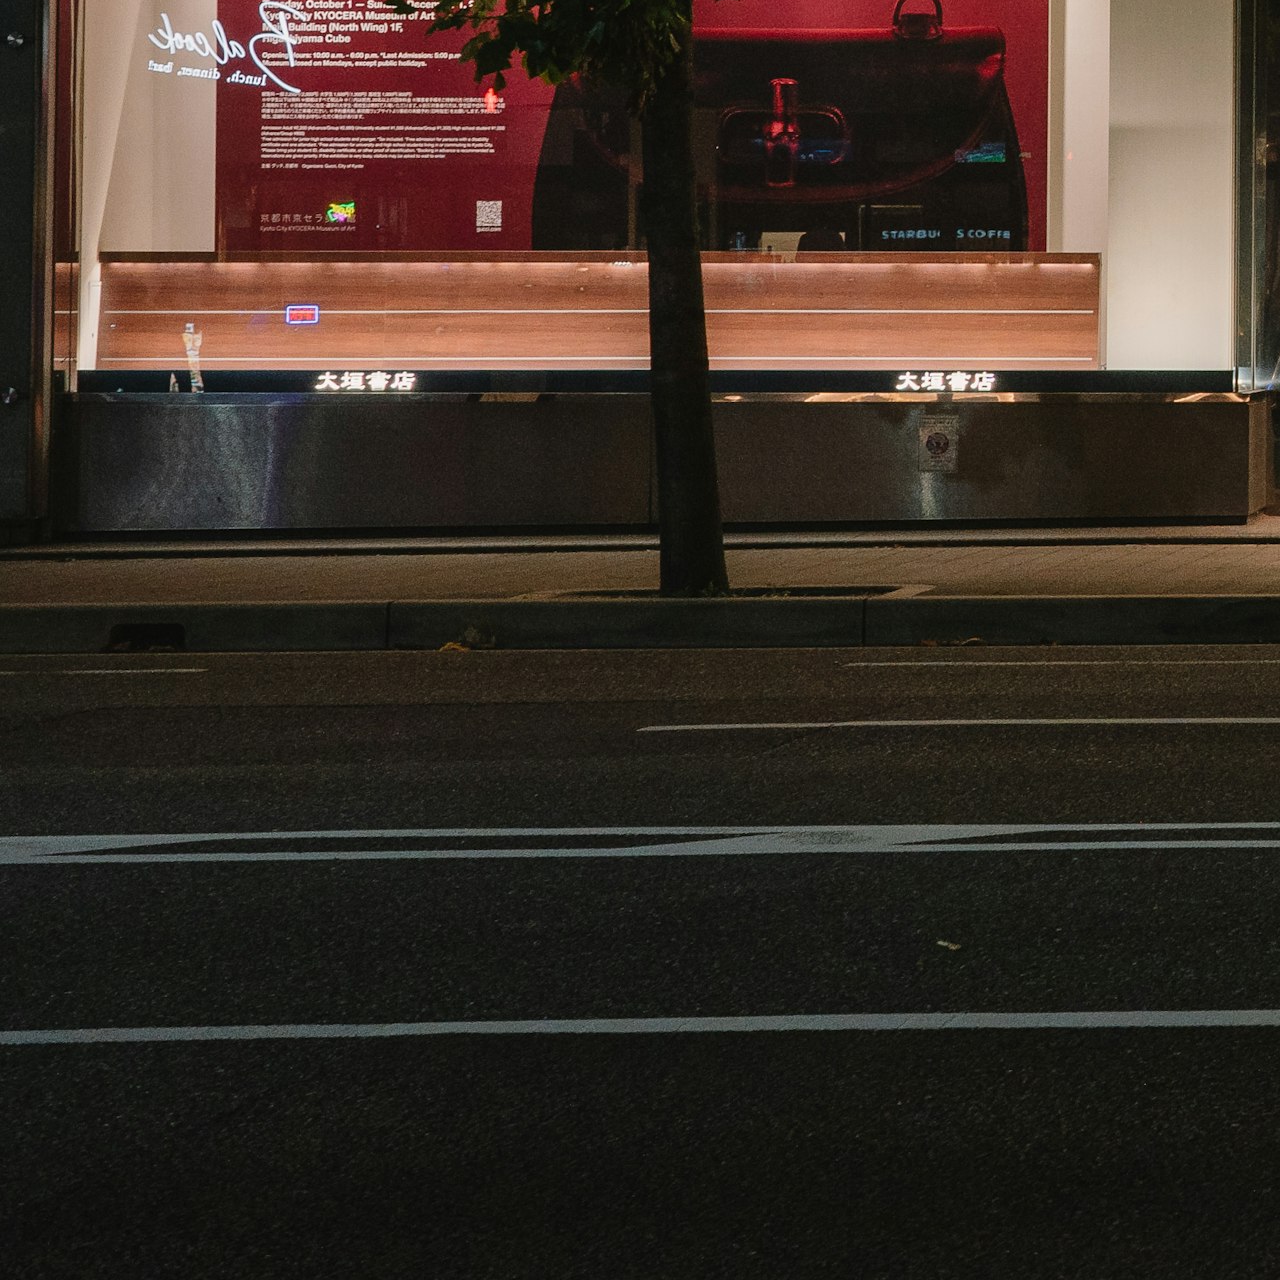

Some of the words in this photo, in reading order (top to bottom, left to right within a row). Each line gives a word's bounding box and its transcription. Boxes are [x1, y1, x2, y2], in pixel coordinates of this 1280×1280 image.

[306, 0, 345, 9] October
[347, 0, 352, 9] 1
[367, 0, 397, 9] Sun
[264, 11, 290, 22] Kyoo
[314, 11, 362, 20] KYOCERA
[365, 11, 406, 20] Museum
[408, 11, 420, 20] of
[421, 11, 435, 20] Art
[262, 23, 287, 32] Mai
[288, 23, 326, 34] Building
[329, 23, 359, 34] (North
[361, 23, 388, 34] Wing)
[390, 23, 404, 33] 1F,
[262, 34, 323, 45] Higaiyama
[325, 34, 351, 43] Cube
[293, 52, 312, 60] ours:
[448, 53, 462, 61] p.m
[377, 60, 397, 69] public
[260, 213, 355, 223] 京都市京セラ
[882, 229, 964, 240] STARBUS
[315, 371, 416, 391] 大垣書店
[895, 371, 996, 391] 大垣書店
